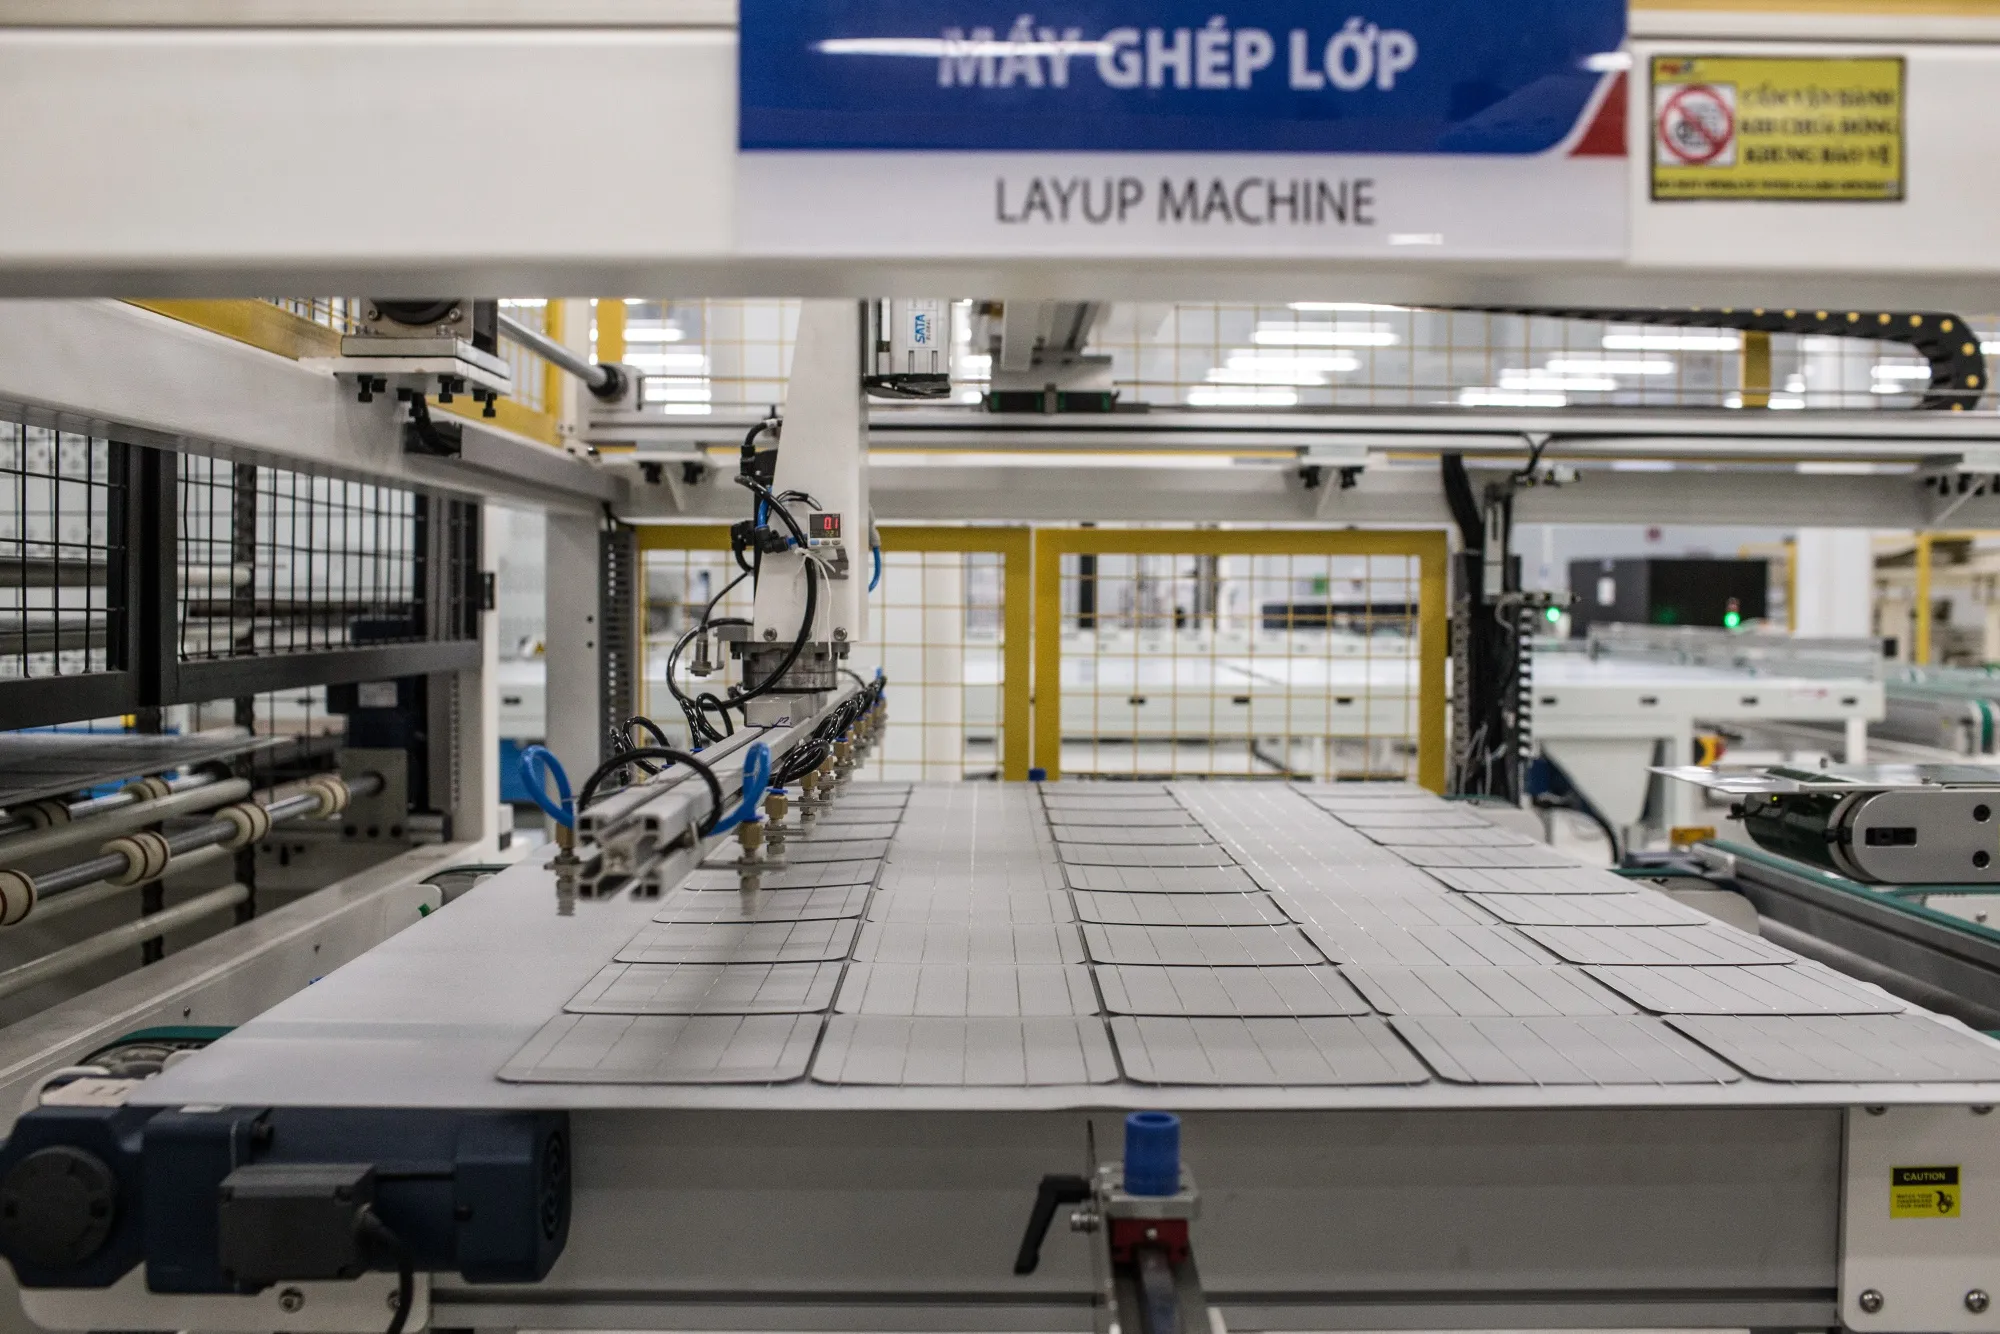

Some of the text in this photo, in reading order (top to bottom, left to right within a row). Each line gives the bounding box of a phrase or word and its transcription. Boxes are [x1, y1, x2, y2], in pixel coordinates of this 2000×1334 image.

[938, 15, 1418, 91] MÁY GHÉP LỚP
[995, 178, 1376, 225] LAYUP MACHINE
[914, 314, 926, 344] SATA
[1902, 1172, 1946, 1181] CAUTION
